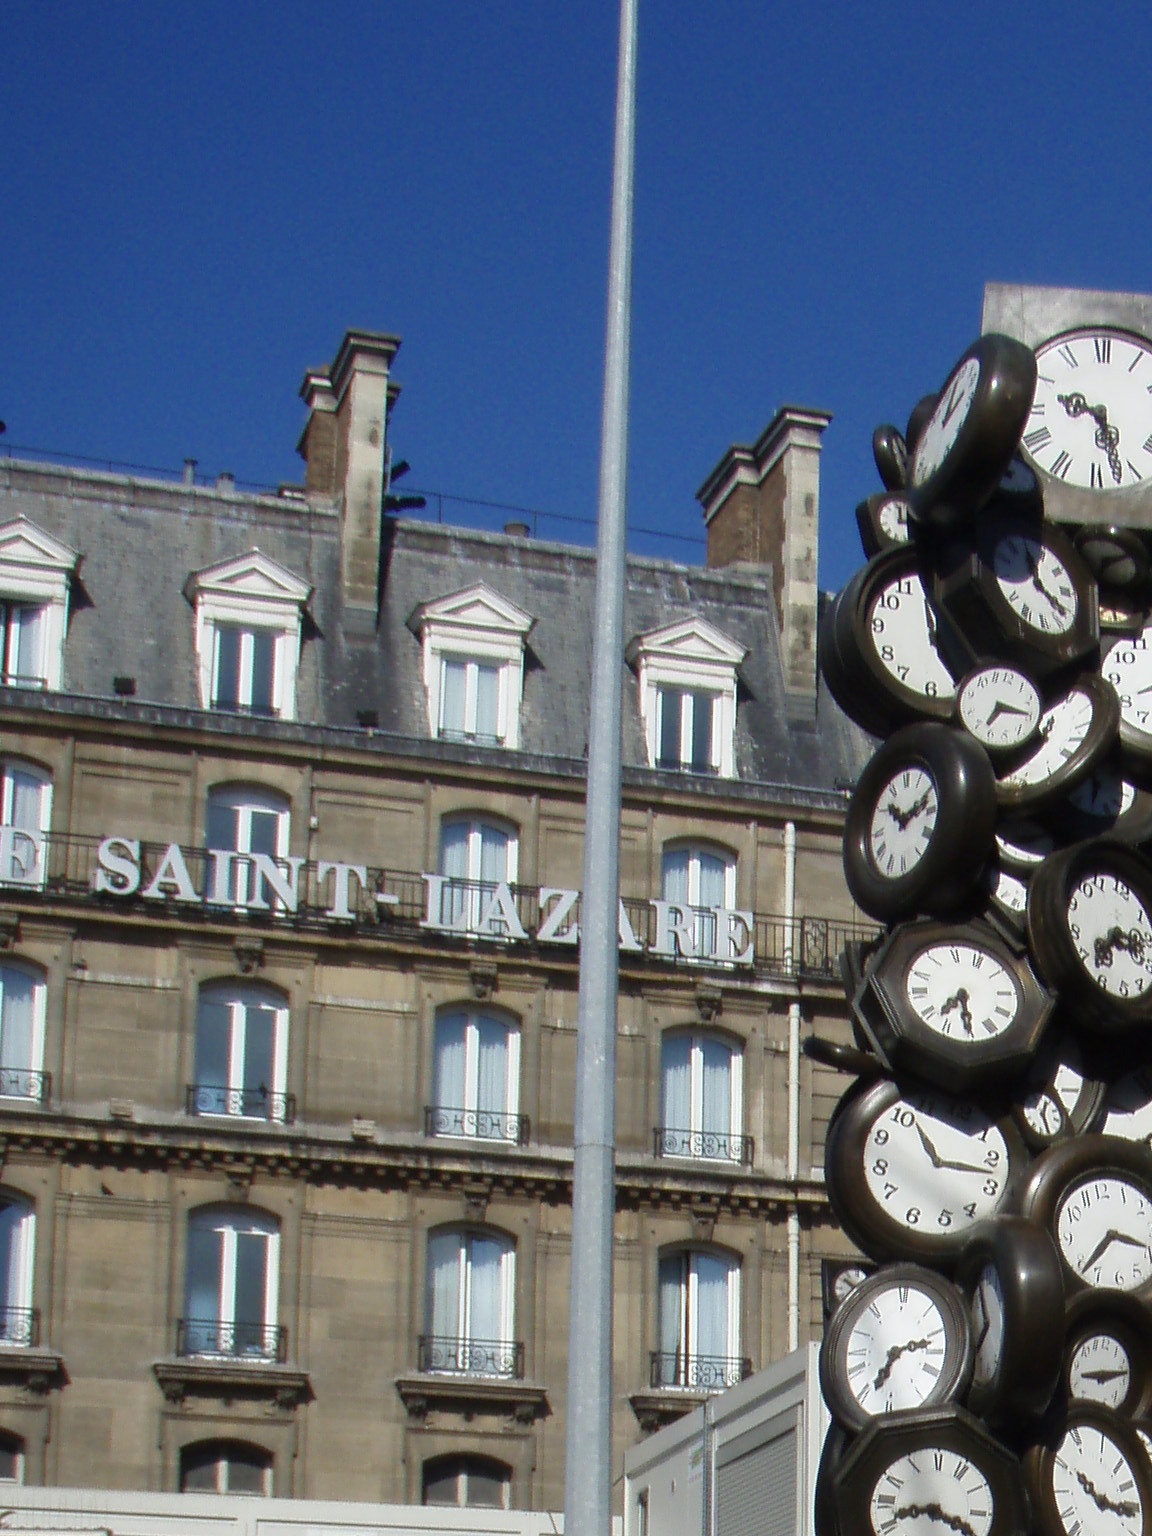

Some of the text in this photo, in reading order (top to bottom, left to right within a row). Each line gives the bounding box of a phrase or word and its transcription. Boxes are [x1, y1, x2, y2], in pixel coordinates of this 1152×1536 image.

[896, 581, 913, 595] 11
[880, 596, 899, 610] 10
[872, 618, 884, 633] 9
[1132, 638, 1147, 650] 11
[881, 645, 894, 661] 8
[1115, 652, 1135, 664] 10
[897, 665, 910, 681] 7
[1108, 672, 1121, 684] 9
[925, 682, 937, 696] 6
[1120, 695, 1132, 708] 8
[1137, 711, 1150, 723] 7
[1113, 880, 1130, 901] 12
[890, 1108, 915, 1127] 10
[874, 1129, 889, 1145] 9
[984, 1150, 1000, 1166] 2
[872, 1159, 888, 1176] 8
[884, 1182, 898, 1200] 7
[983, 1179, 998, 1196] 3
[1095, 1183, 1110, 1200] 12
[1121, 1187, 1126, 1204] 1
[1081, 1190, 1090, 1208] 11
[906, 1207, 921, 1224] 6
[937, 1209, 953, 1226] 5
[963, 1202, 978, 1218] 4
[1067, 1205, 1081, 1223] 10
[1093, 1266, 1102, 1283] 7
[1115, 1271, 1124, 1285] 6
